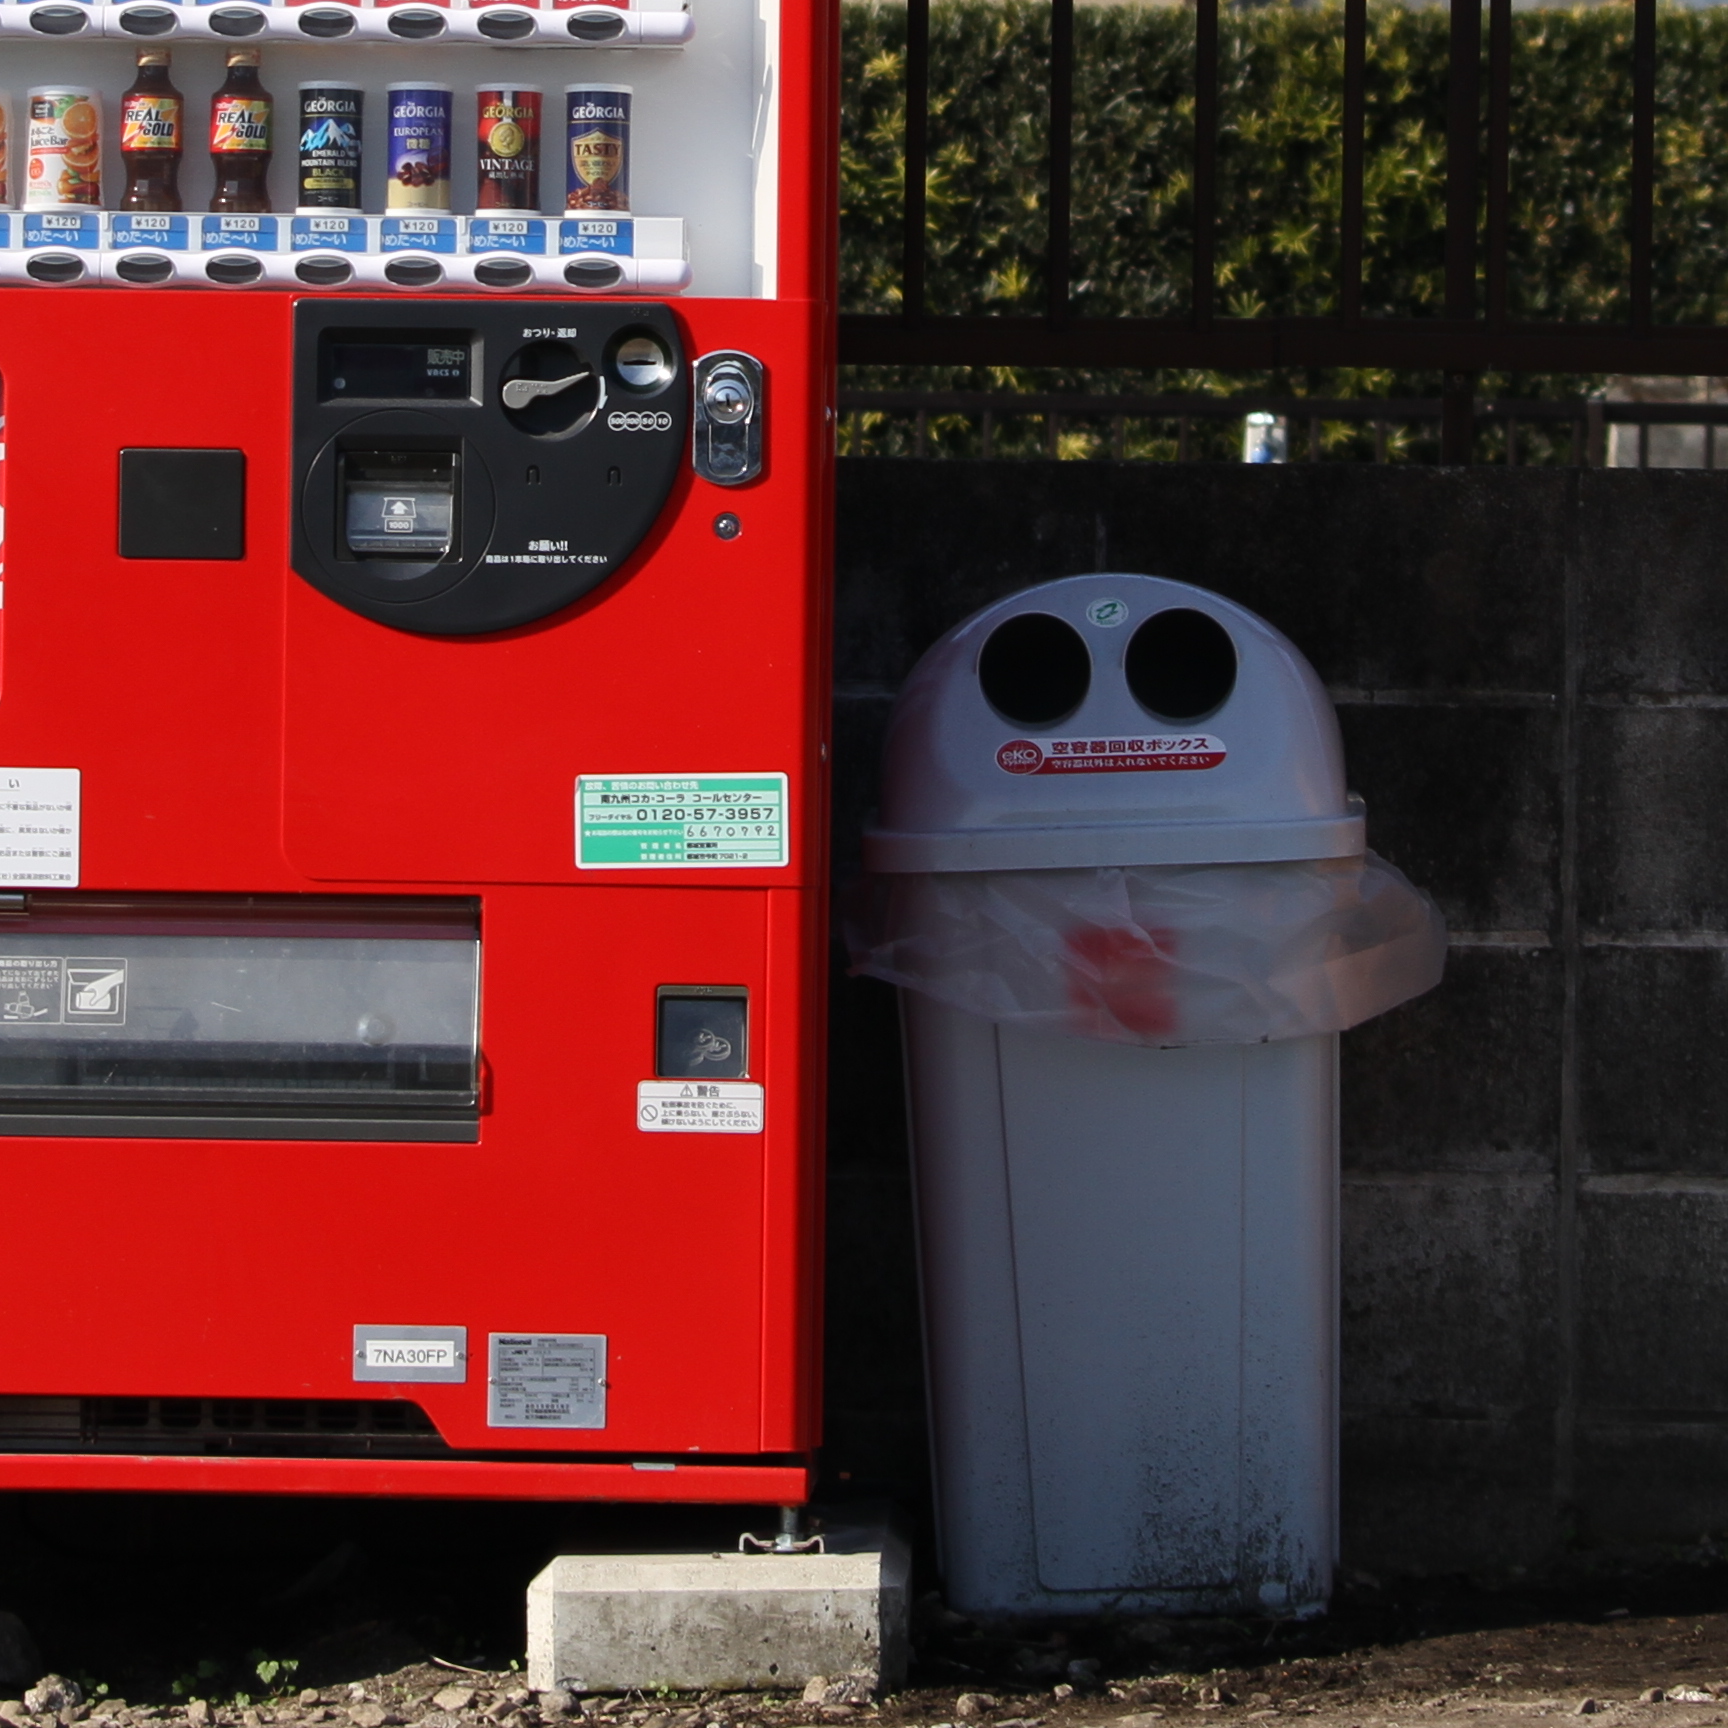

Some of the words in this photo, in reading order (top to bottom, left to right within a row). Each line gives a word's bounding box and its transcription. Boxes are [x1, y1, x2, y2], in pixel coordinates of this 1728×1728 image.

[125, 106, 162, 122] REAL
[217, 108, 255, 124] REAL
[142, 122, 175, 137] GOLD
[235, 124, 267, 139] GOLD
[393, 126, 444, 137] EUROPEAN
[50, 135, 68, 146] Bar
[574, 143, 621, 156] TASTY
[480, 158, 536, 171] VINTAGE
[45, 216, 78, 226] ¥120
[134, 218, 167, 228] ¥120
[223, 219, 256, 229] ¥120
[313, 220, 345, 230] ¥120
[402, 221, 435, 231] ¥120
[492, 222, 524, 232] ¥120
[581, 223, 614, 233] ¥120
[427, 348, 465, 365] 販売中
[1051, 738, 1210, 755] 空容器回収ボックス
[1051, 756, 1211, 769] 空容器以外は入れないでください
[691, 793, 762, 803] コールセンター
[636, 808, 774, 820] 0120-57-3957
[696, 1085, 720, 1097] 警告
[373, 1349, 448, 1364] 7NA30FP
